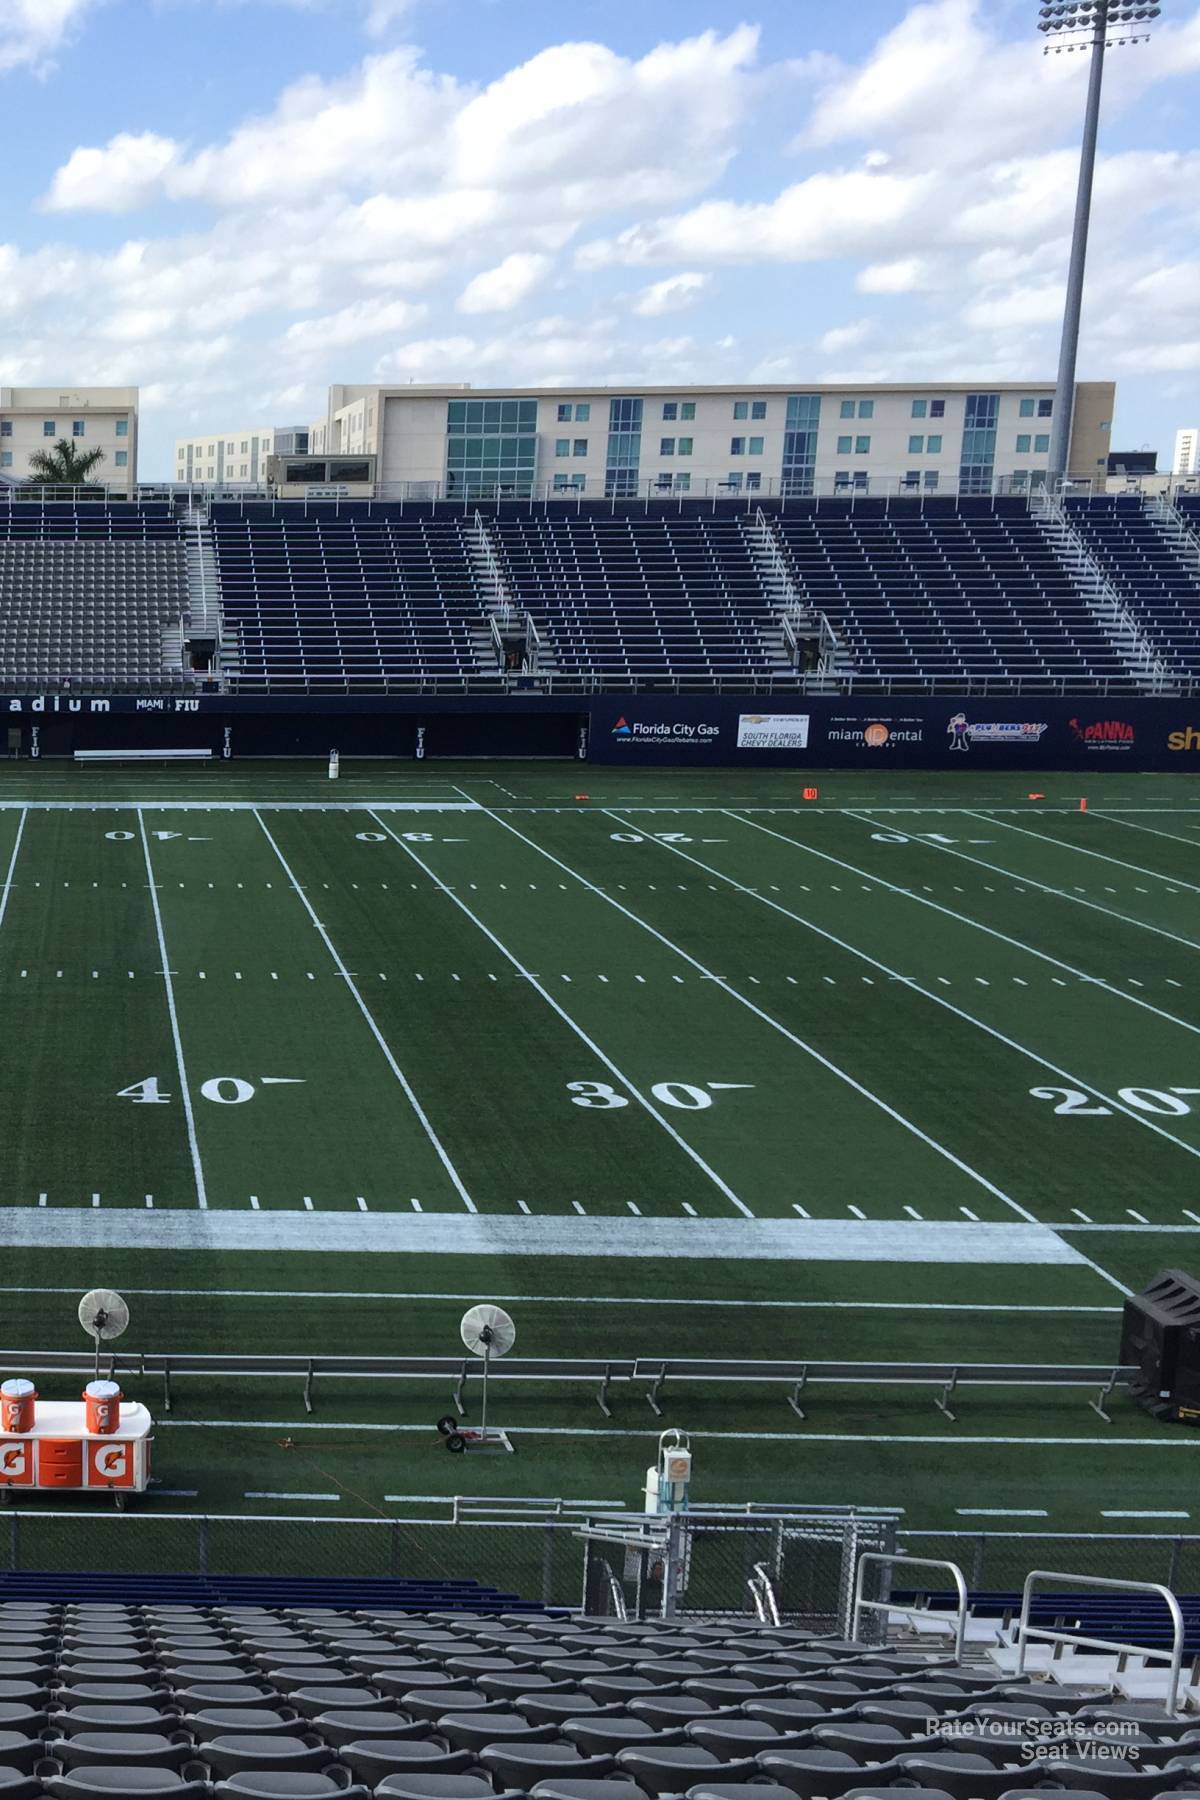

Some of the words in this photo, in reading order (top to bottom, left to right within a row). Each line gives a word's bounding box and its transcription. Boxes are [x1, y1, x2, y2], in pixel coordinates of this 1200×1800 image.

[136, 699, 164, 710] MIAMI
[174, 699, 200, 711] FIU
[633, 723, 671, 735] Florida
[672, 723, 696, 737] City
[697, 723, 720, 735] Gas
[117, 1076, 255, 1104] 40
[566, 1081, 712, 1110] 30
[1029, 1086, 1191, 1116] 20
[8, 1403, 19, 1415] G
[97, 1405, 108, 1416] G
[94, 1443, 126, 1478] G
